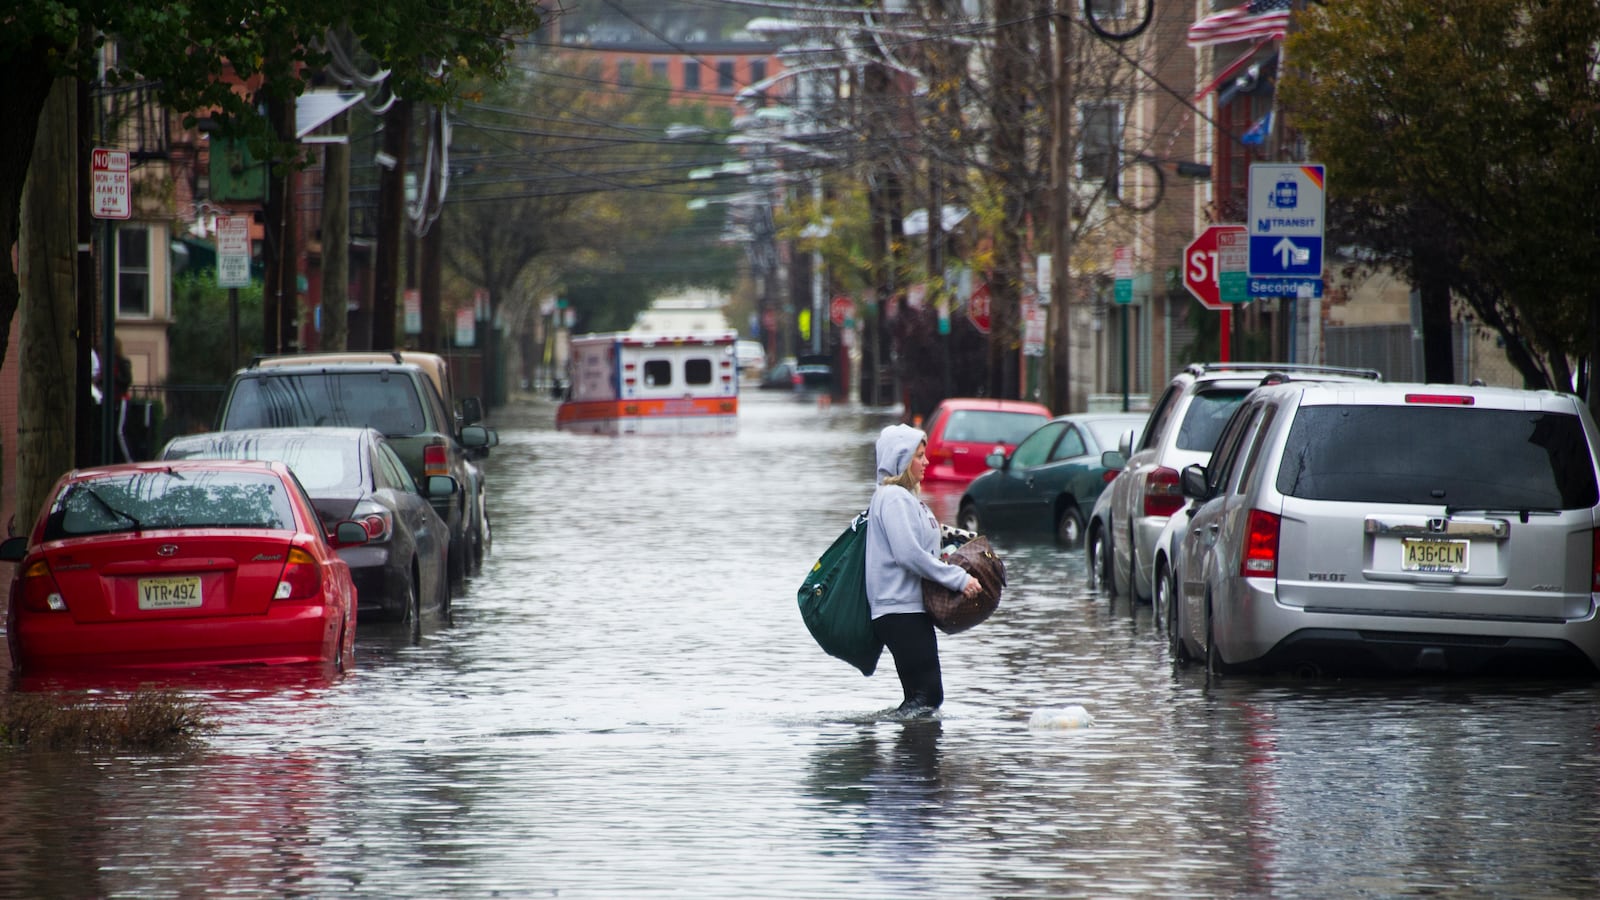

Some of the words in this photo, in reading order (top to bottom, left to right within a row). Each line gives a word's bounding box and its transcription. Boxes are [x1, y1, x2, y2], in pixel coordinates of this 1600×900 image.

[94, 153, 108, 168] NO
[114, 174, 125, 183] SAT
[115, 186, 125, 196] TO
[1272, 218, 1316, 227] TRANSIT
[1189, 251, 1219, 283] ST
[1251, 279, 1298, 293] Second
[1308, 572, 1347, 582] PILOT
